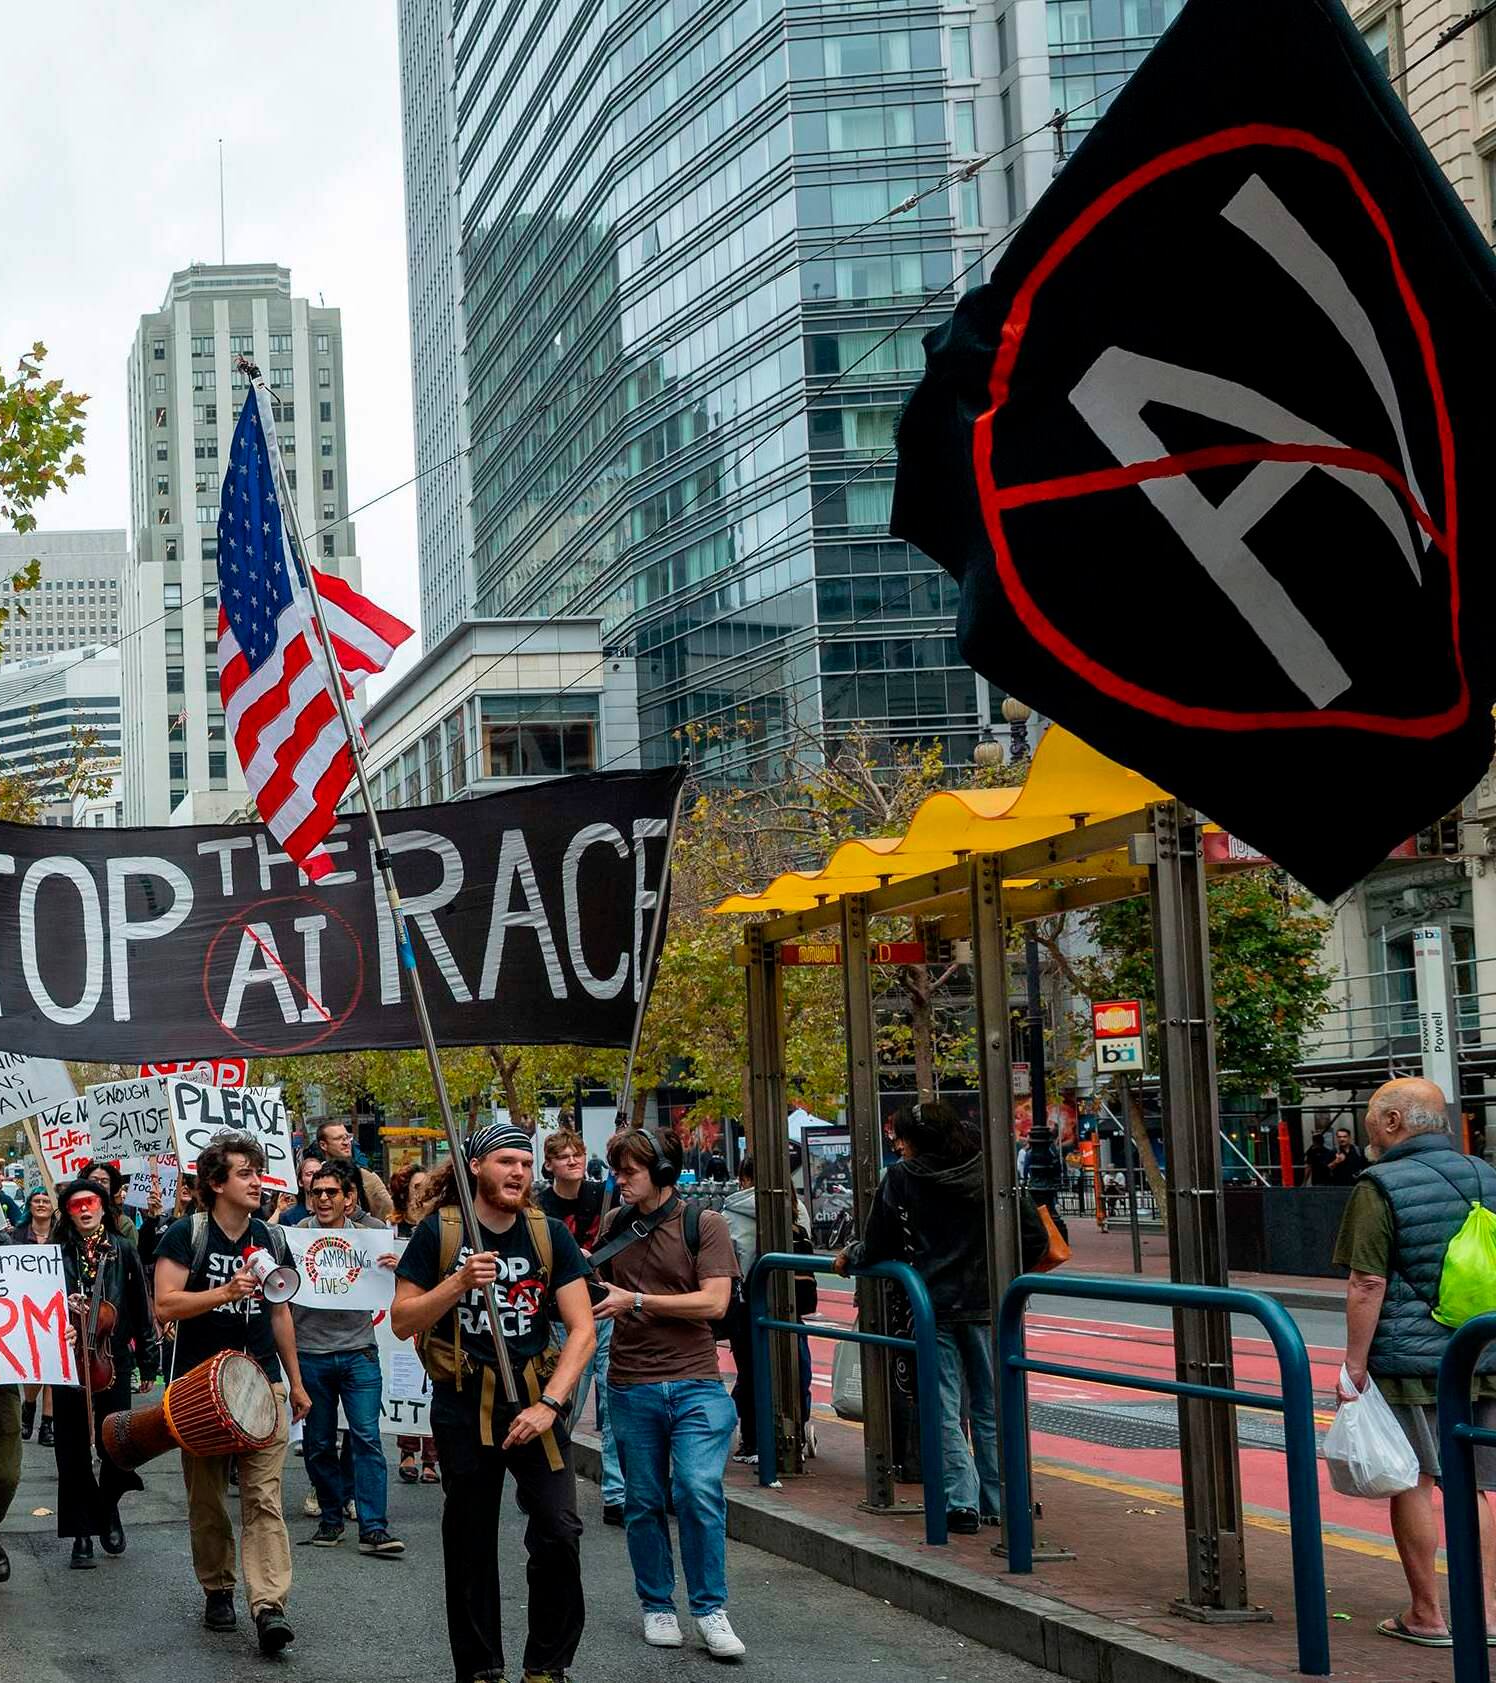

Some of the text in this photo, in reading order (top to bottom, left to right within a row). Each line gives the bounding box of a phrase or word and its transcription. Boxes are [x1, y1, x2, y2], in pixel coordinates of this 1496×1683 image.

[197, 823, 357, 897] THE
[221, 914, 332, 1029] AI
[1419, 1012, 1430, 1054] Powell
[1431, 1011, 1446, 1054] Powell
[93, 1084, 151, 1106] ENOUGH
[174, 1082, 285, 1136] PLEASE
[40, 1102, 74, 1127] We
[99, 1107, 170, 1141] SATISF
[132, 1139, 162, 1153] PAUSE
[184, 1128, 287, 1174] SP
[208, 1252, 246, 1274] STO
[455, 1246, 530, 1282] SOP
[314, 1277, 350, 1295] LIVES
[457, 1306, 532, 1338] RACE
